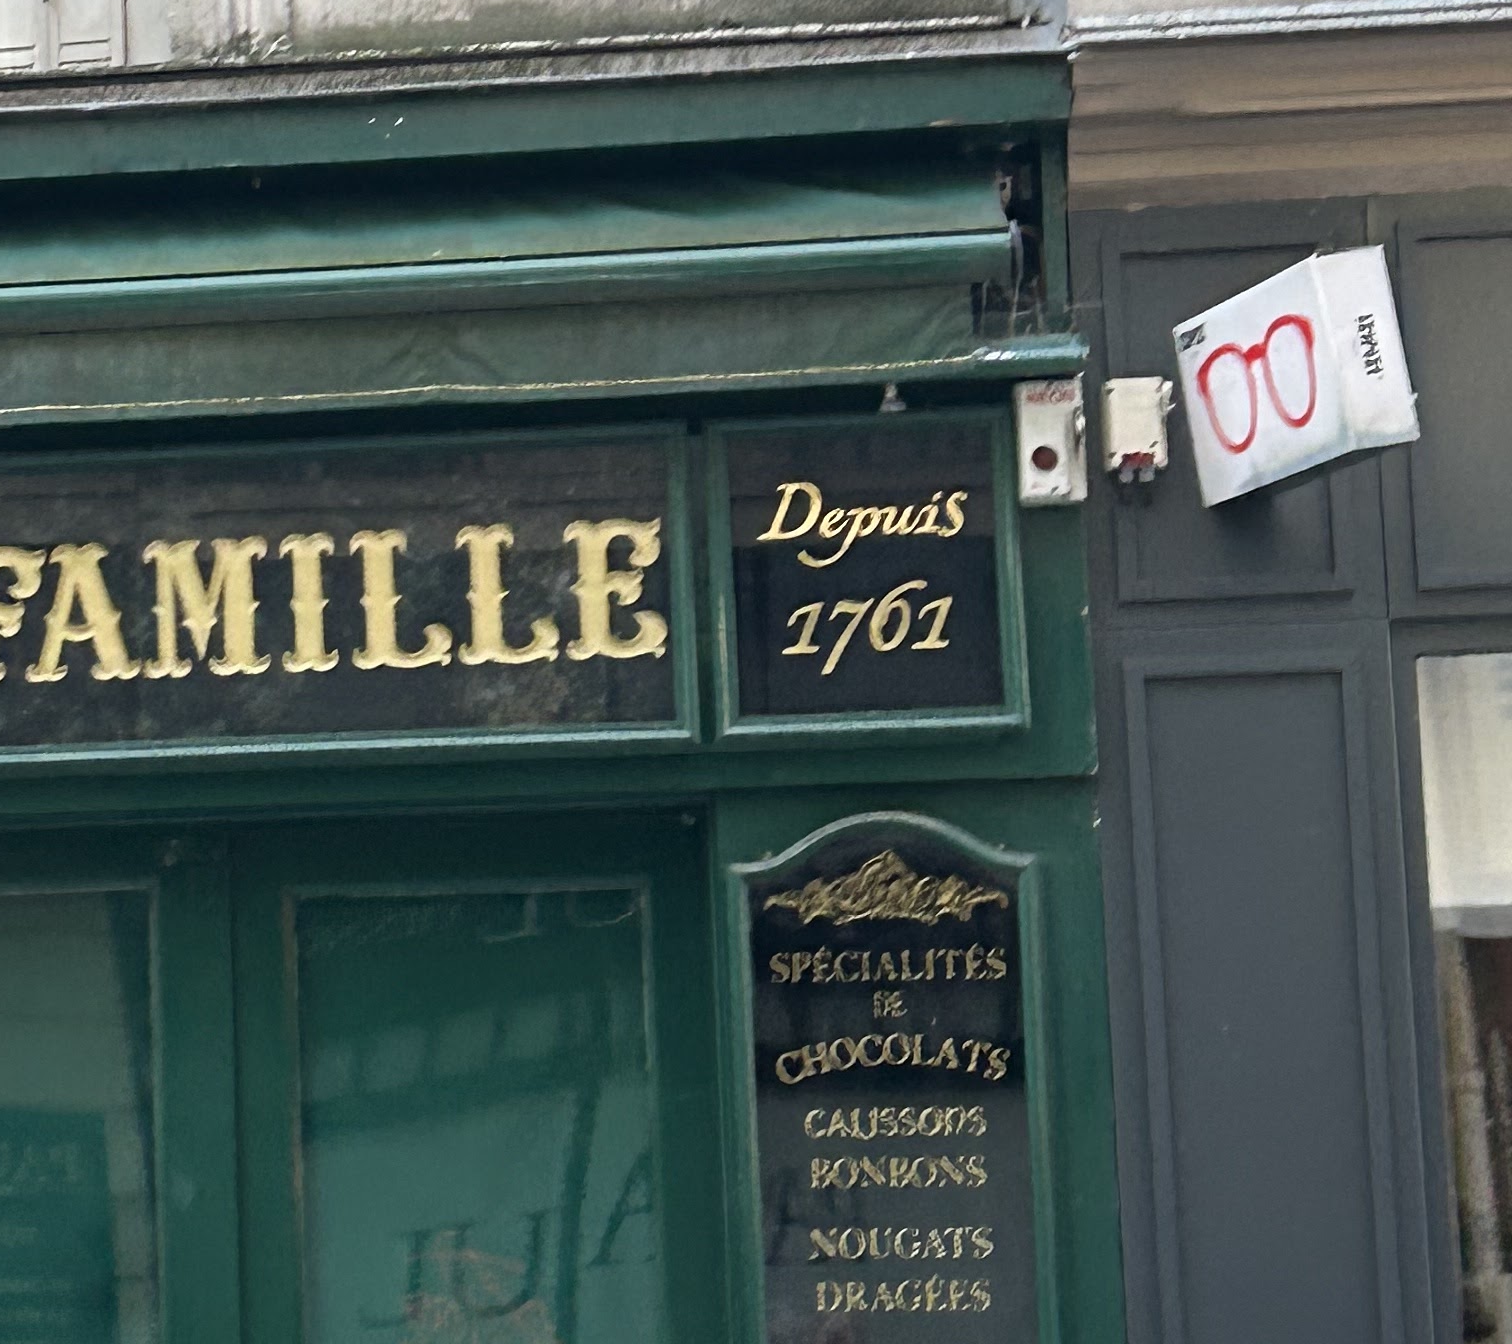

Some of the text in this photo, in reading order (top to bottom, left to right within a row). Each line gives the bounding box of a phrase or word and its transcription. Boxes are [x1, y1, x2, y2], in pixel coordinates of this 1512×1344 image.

[756, 481, 969, 568] Depuis
[781, 579, 955, 676] 1761
[769, 942, 1007, 984] SPÉCIALITÉS
[774, 1032, 1011, 1086] CHOCOLATS
[809, 1154, 989, 1190] BONBONS
[807, 1226, 995, 1261] NOUGATS
[815, 1273, 992, 1313] DRAGÉES
